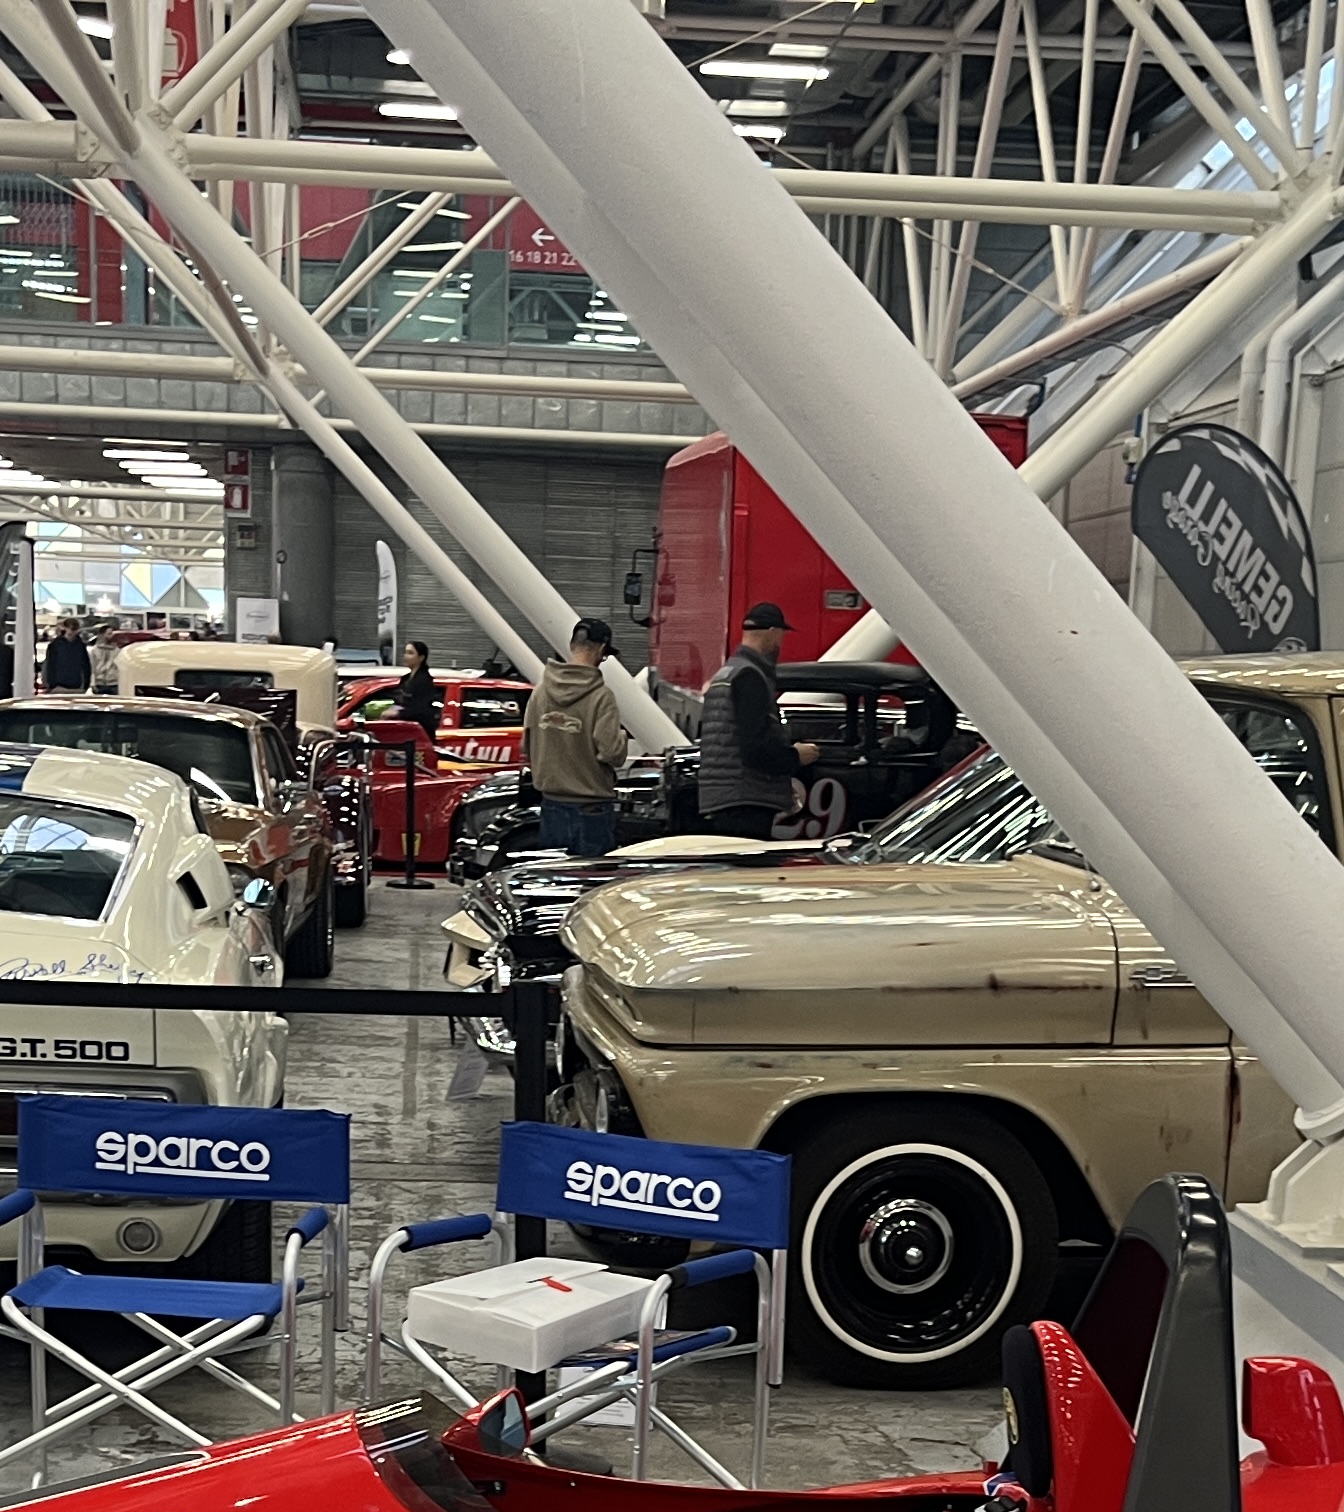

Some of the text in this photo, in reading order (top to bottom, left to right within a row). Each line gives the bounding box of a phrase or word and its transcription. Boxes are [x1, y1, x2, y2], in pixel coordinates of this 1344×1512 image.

[527, 251, 541, 264] 18
[544, 251, 558, 265] 21
[53, 1038, 130, 1062] 500
[95, 1131, 271, 1177] sparco
[565, 1160, 722, 1216] sparco
